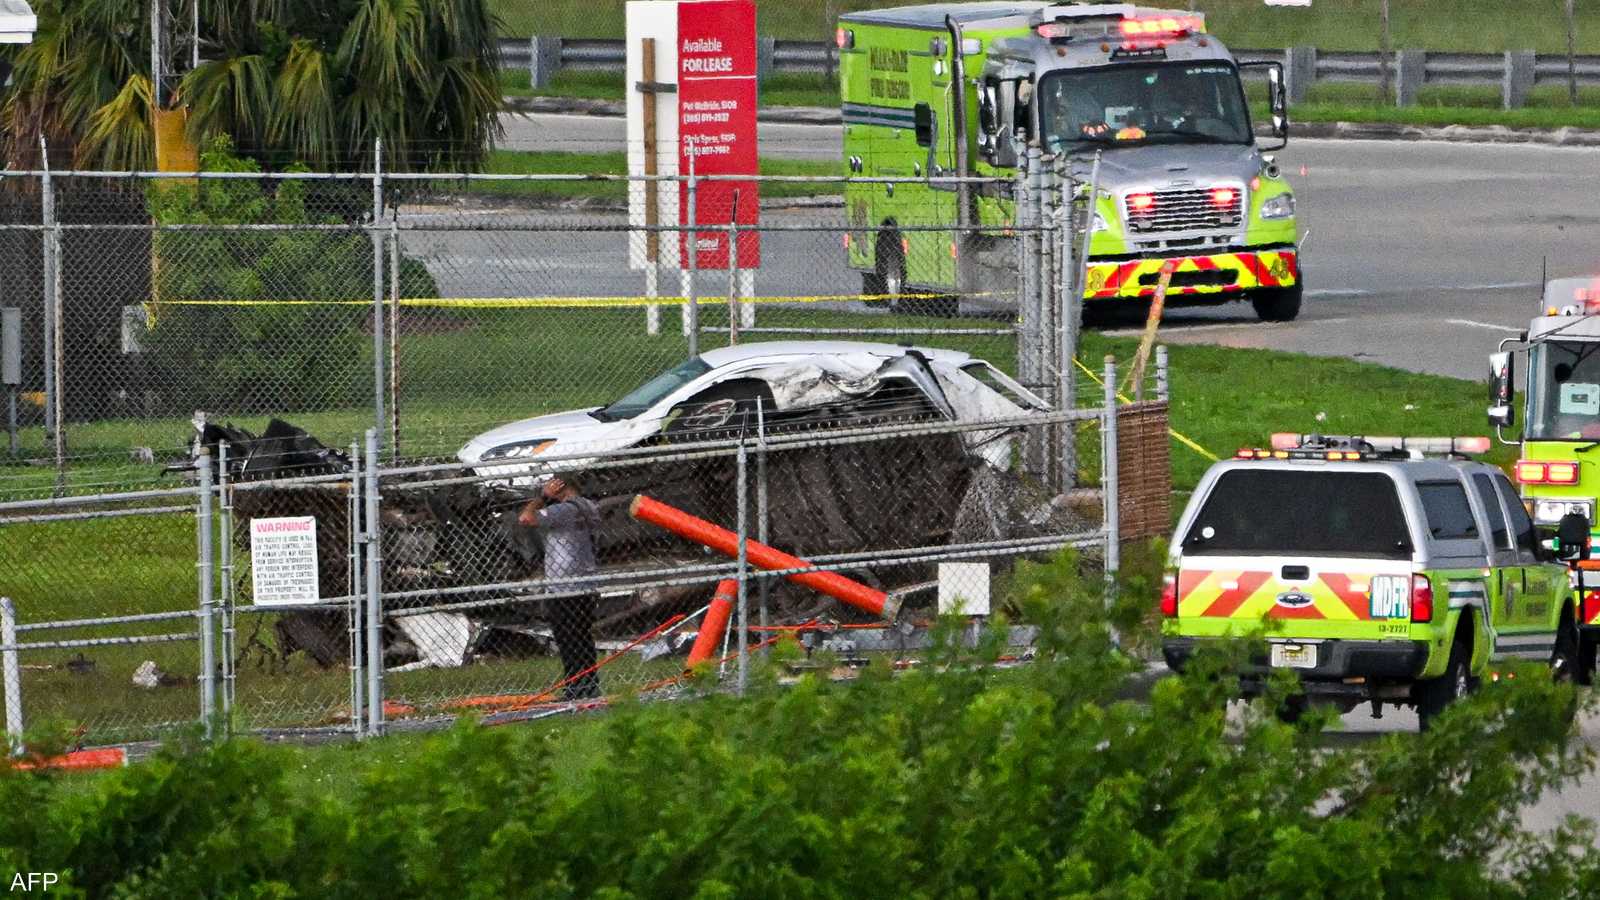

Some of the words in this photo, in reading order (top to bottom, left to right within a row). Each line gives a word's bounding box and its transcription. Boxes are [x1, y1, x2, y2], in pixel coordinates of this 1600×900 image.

[683, 37, 722, 52] Available
[683, 57, 703, 72] FOR
[703, 56, 733, 72] LEASE
[256, 522, 310, 532] WARNING
[1371, 575, 1408, 618] MDFR
